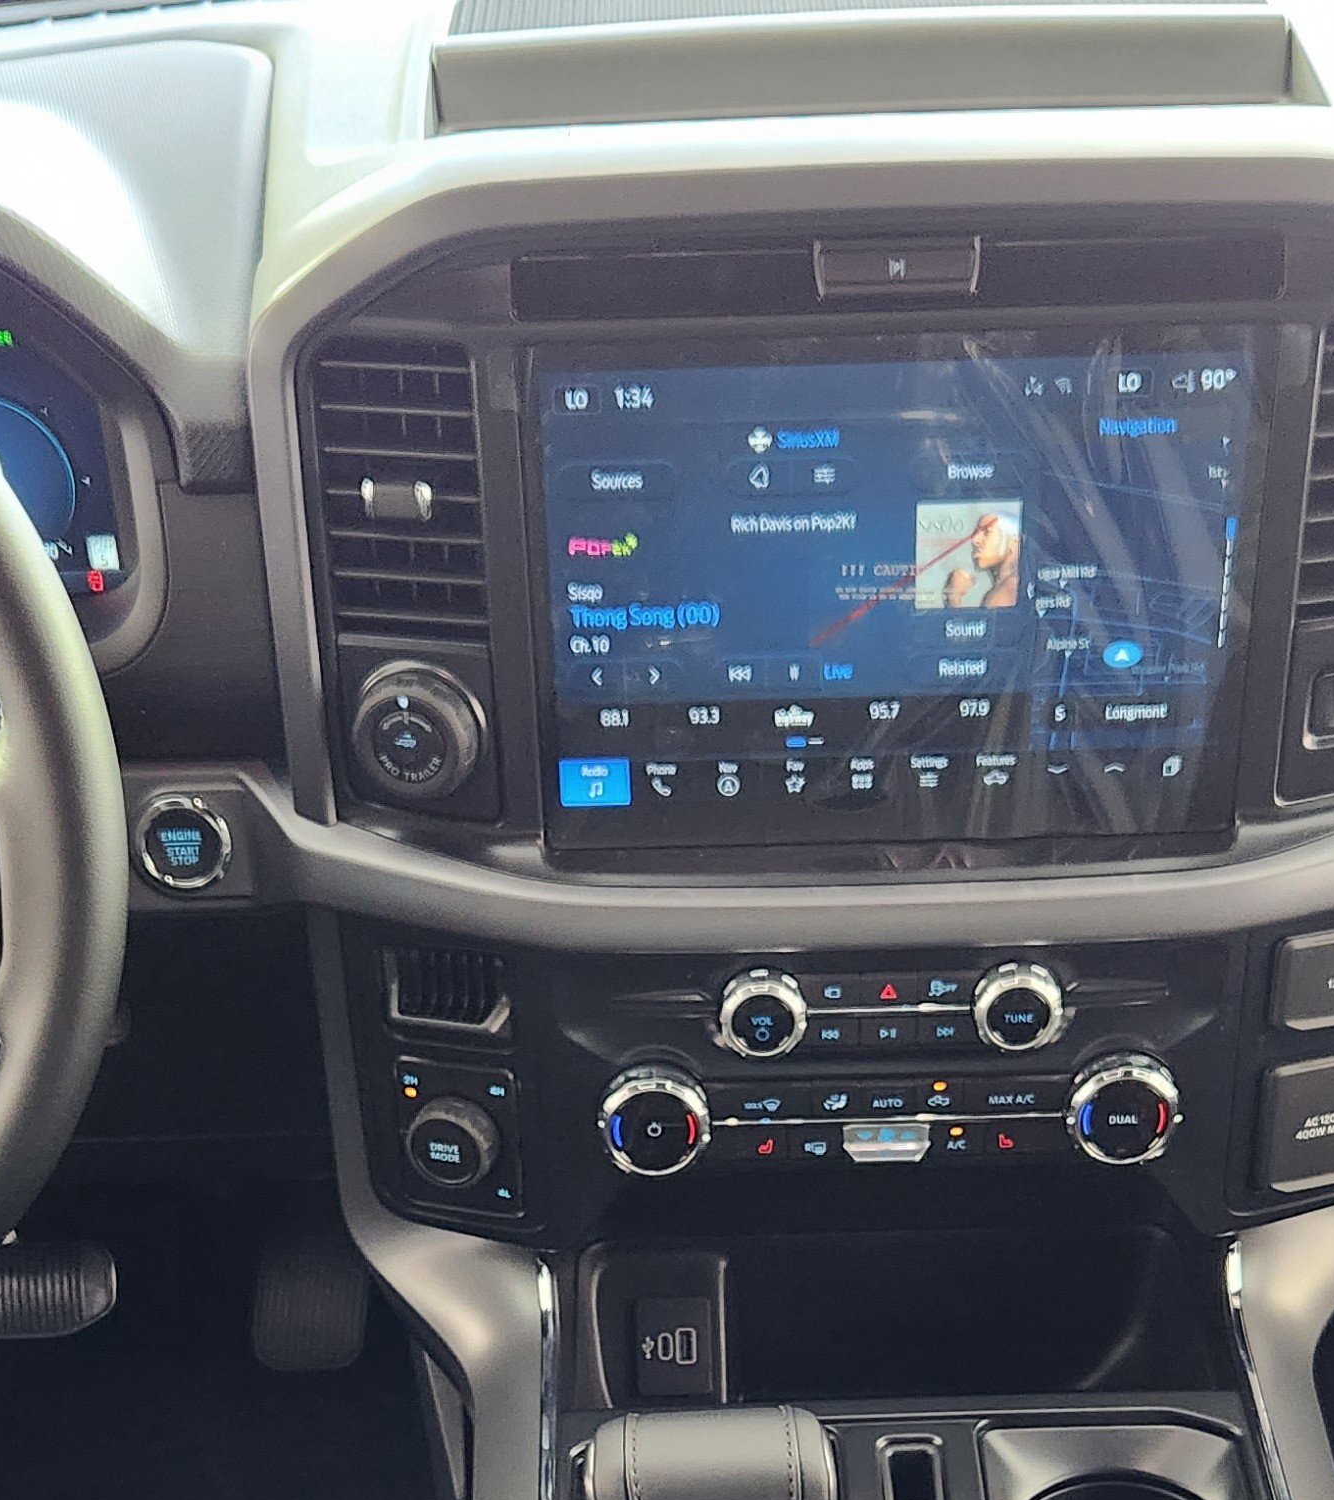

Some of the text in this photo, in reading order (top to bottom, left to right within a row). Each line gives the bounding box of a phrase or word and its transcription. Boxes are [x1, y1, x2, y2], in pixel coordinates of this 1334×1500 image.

[1118, 371, 1143, 393] LO
[564, 387, 589, 410] LO
[614, 384, 654, 410] 1:34
[1098, 416, 1178, 437] Navigation
[776, 429, 840, 449] SiriusXM
[591, 470, 643, 491] Sources
[946, 462, 995, 481] Browse
[730, 513, 759, 534] Rich
[759, 513, 793, 533] Davis
[793, 516, 810, 531] on
[569, 602, 720, 631] Thong Song (00)
[945, 619, 987, 638] Sound
[823, 663, 854, 681] Live
[937, 658, 987, 678] Related
[688, 705, 720, 726] 93.3
[868, 701, 901, 721] 95.7
[958, 698, 991, 718] 97.9
[1104, 703, 1168, 721] Longmont
[599, 707, 630, 728] 88.1
[379, 753, 442, 783] PRO TRAILER
[646, 763, 678, 776] Phone
[718, 761, 738, 774] Nav
[785, 758, 806, 773] Fav
[849, 758, 875, 771] Apps
[910, 756, 950, 770] Settings
[975, 754, 1018, 767] Features
[160, 829, 202, 842] ENGINE
[167, 846, 200, 857] START
[170, 856, 199, 866] STOP
[750, 1016, 774, 1026] VOL
[1004, 1013, 1034, 1024] TUNE
[872, 1098, 903, 1109] AUTO
[988, 1093, 1036, 1105] MAX A/C
[1108, 1114, 1138, 1125] DUAL
[429, 1141, 460, 1155] DRIVE
[946, 1140, 966, 1150] A/C
[430, 1151, 461, 1164] MODE
